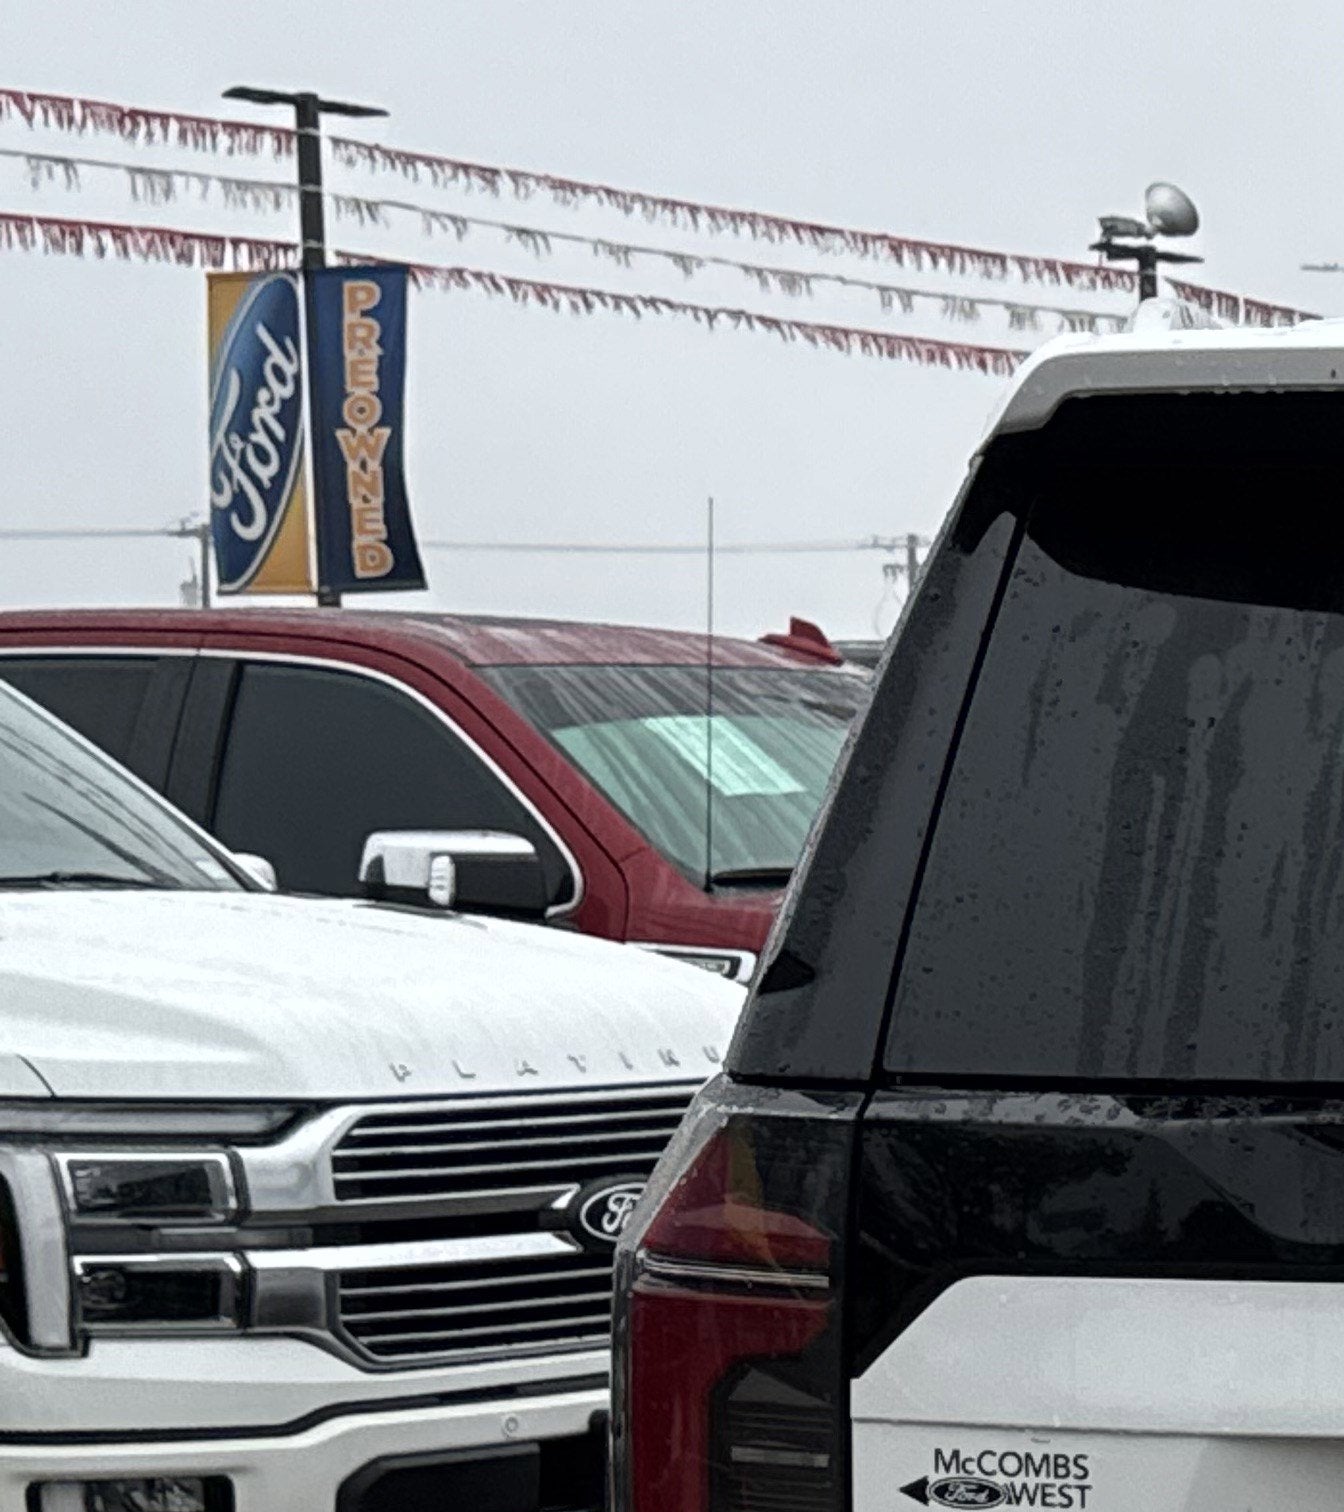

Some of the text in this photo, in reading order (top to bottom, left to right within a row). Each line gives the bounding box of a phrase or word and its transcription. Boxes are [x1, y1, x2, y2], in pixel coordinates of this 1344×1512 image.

[210, 322, 299, 541] Ford
[335, 279, 394, 579] PREOWNED
[389, 1045, 721, 1083] PLATINU
[933, 1448, 1090, 1480] McCOMBS
[1005, 1483, 1093, 1508] WEST
